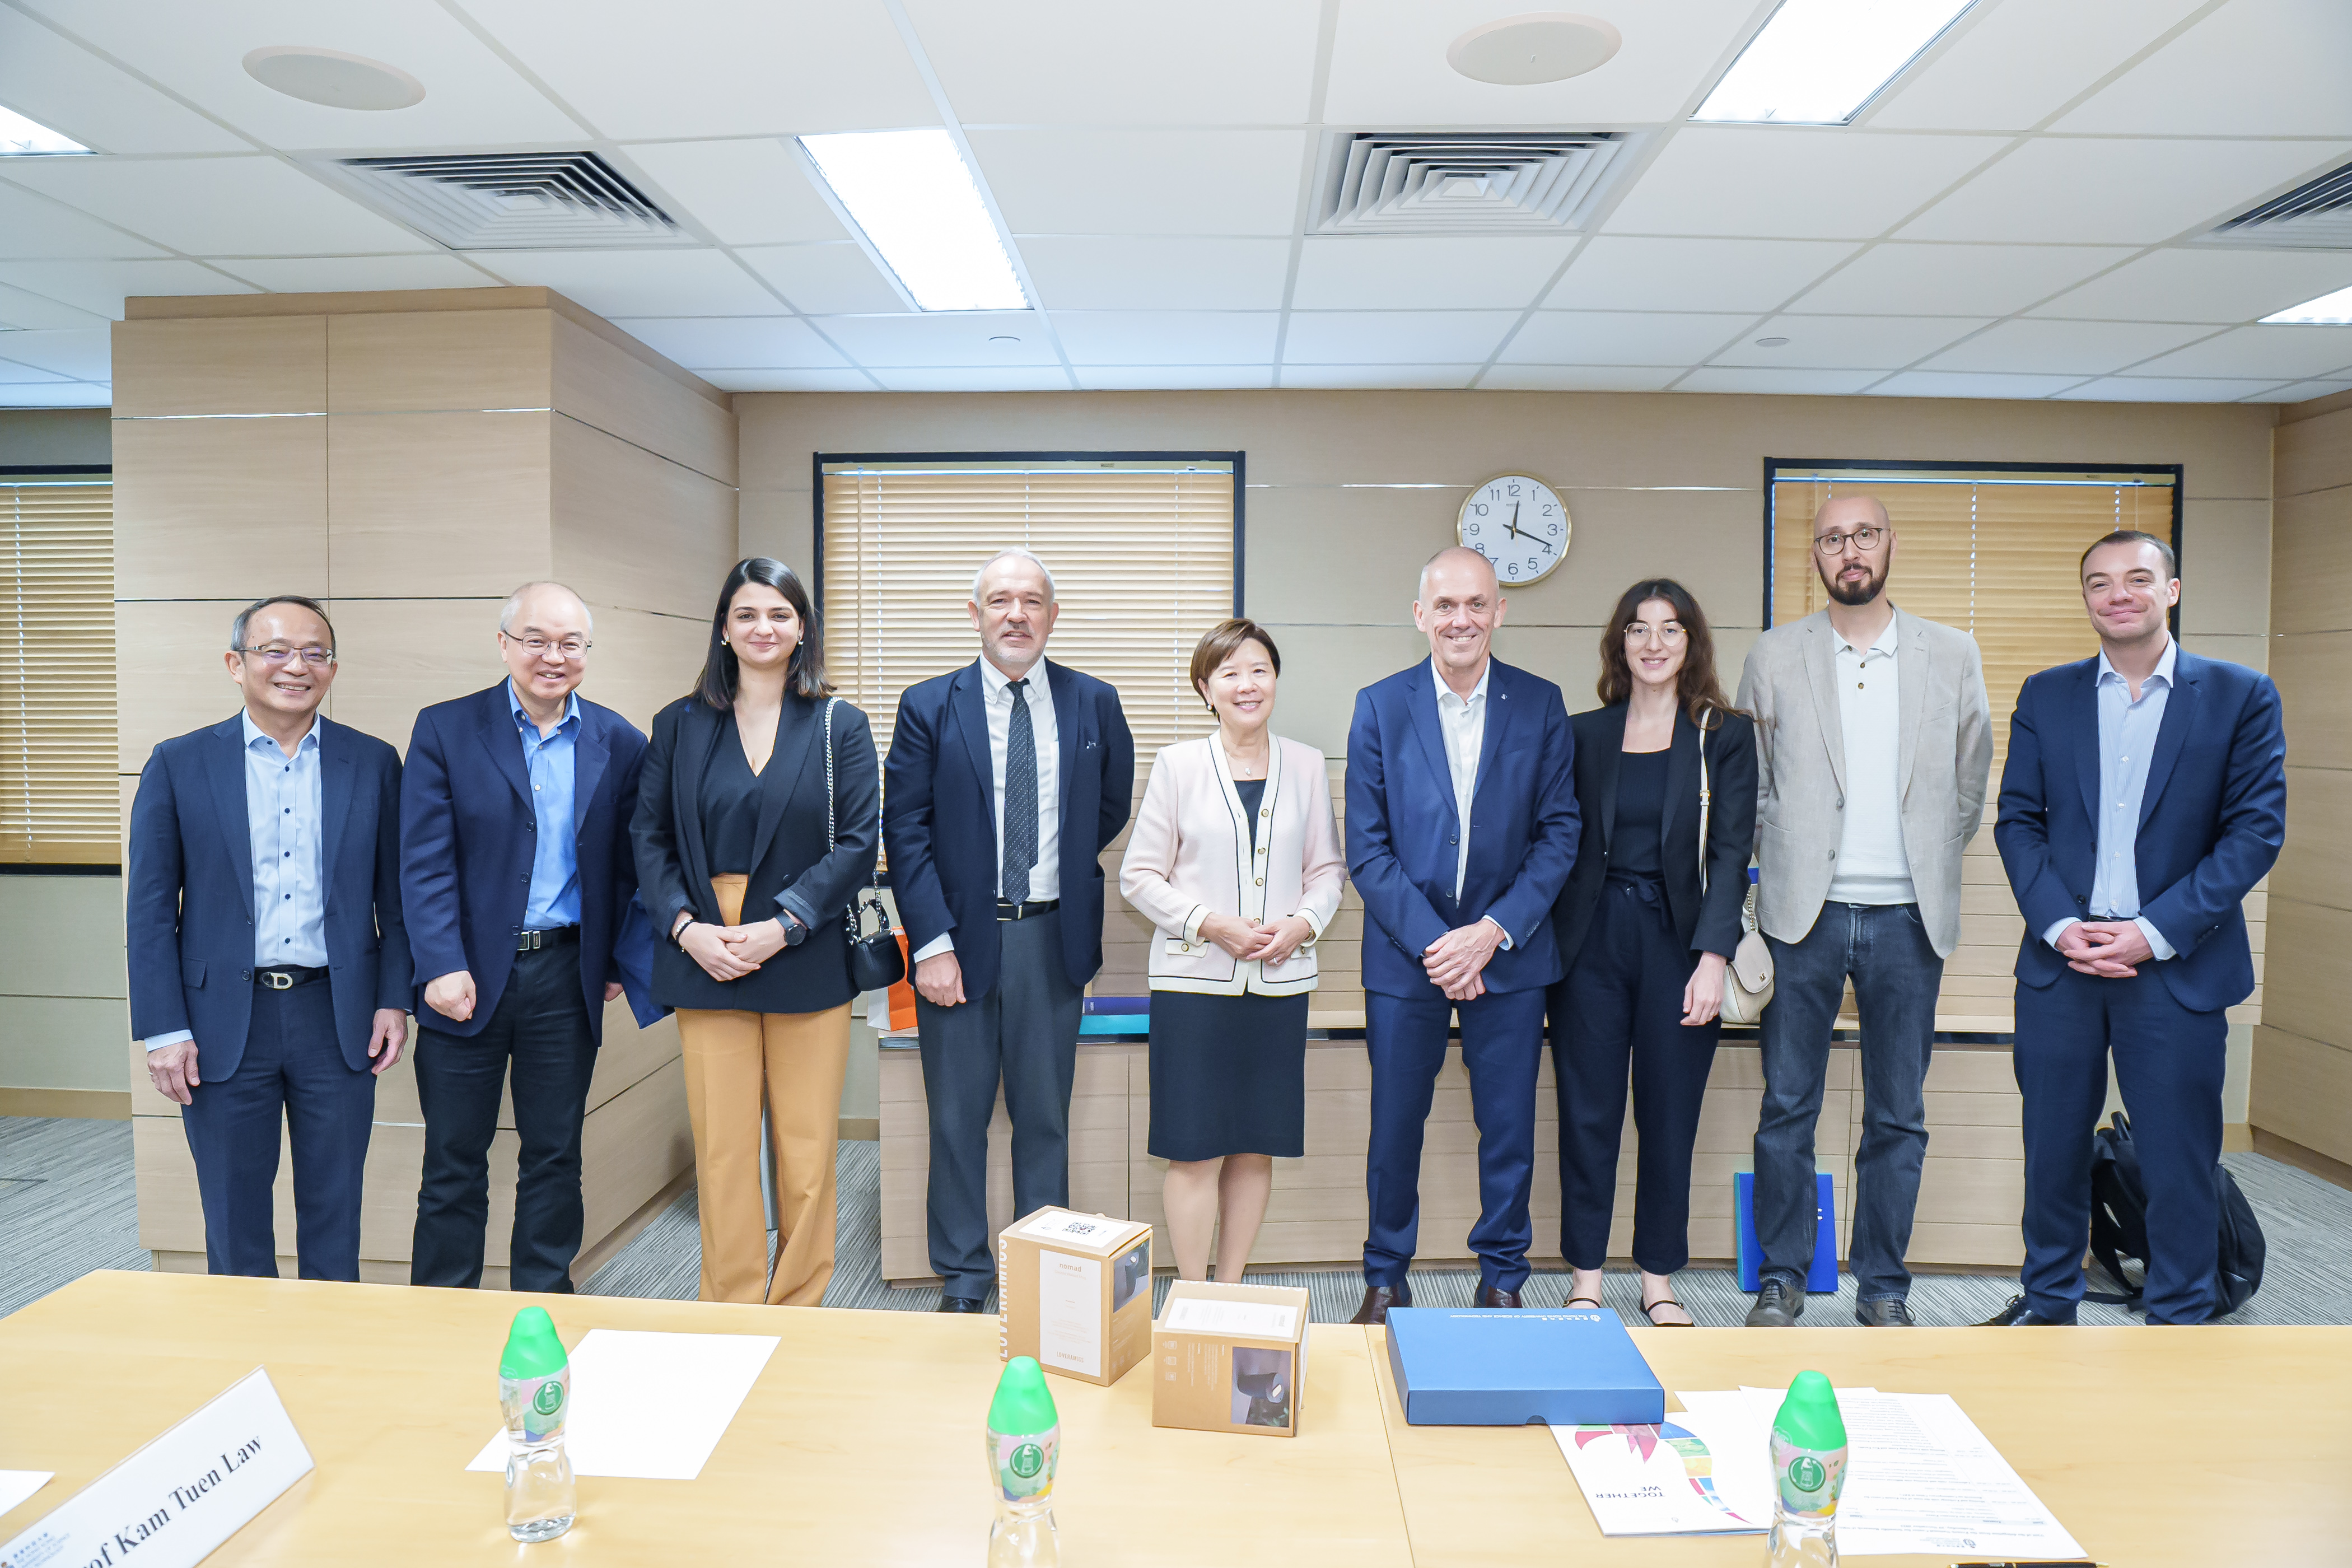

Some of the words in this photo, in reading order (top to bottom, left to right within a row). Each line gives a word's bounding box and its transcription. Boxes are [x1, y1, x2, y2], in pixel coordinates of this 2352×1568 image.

[1490, 489, 1500, 501] 11
[1508, 484, 1521, 497] 12
[1532, 489, 1536, 501] 1
[1474, 504, 1489, 516] 10
[1542, 505, 1552, 516] 2
[1469, 524, 1480, 535] 9
[1547, 524, 1557, 536] 3
[1474, 543, 1485, 555] 8
[1542, 544, 1552, 555] 4
[1508, 563, 1518, 575] 6
[1528, 558, 1538, 570] 5
[1059, 1263, 1082, 1272] nomad
[1056, 1351, 1084, 1363] LOVERAMICS
[113, 1508, 171, 1555] Kam
[167, 1469, 222, 1511] Tuen
[220, 1435, 263, 1474] Law
